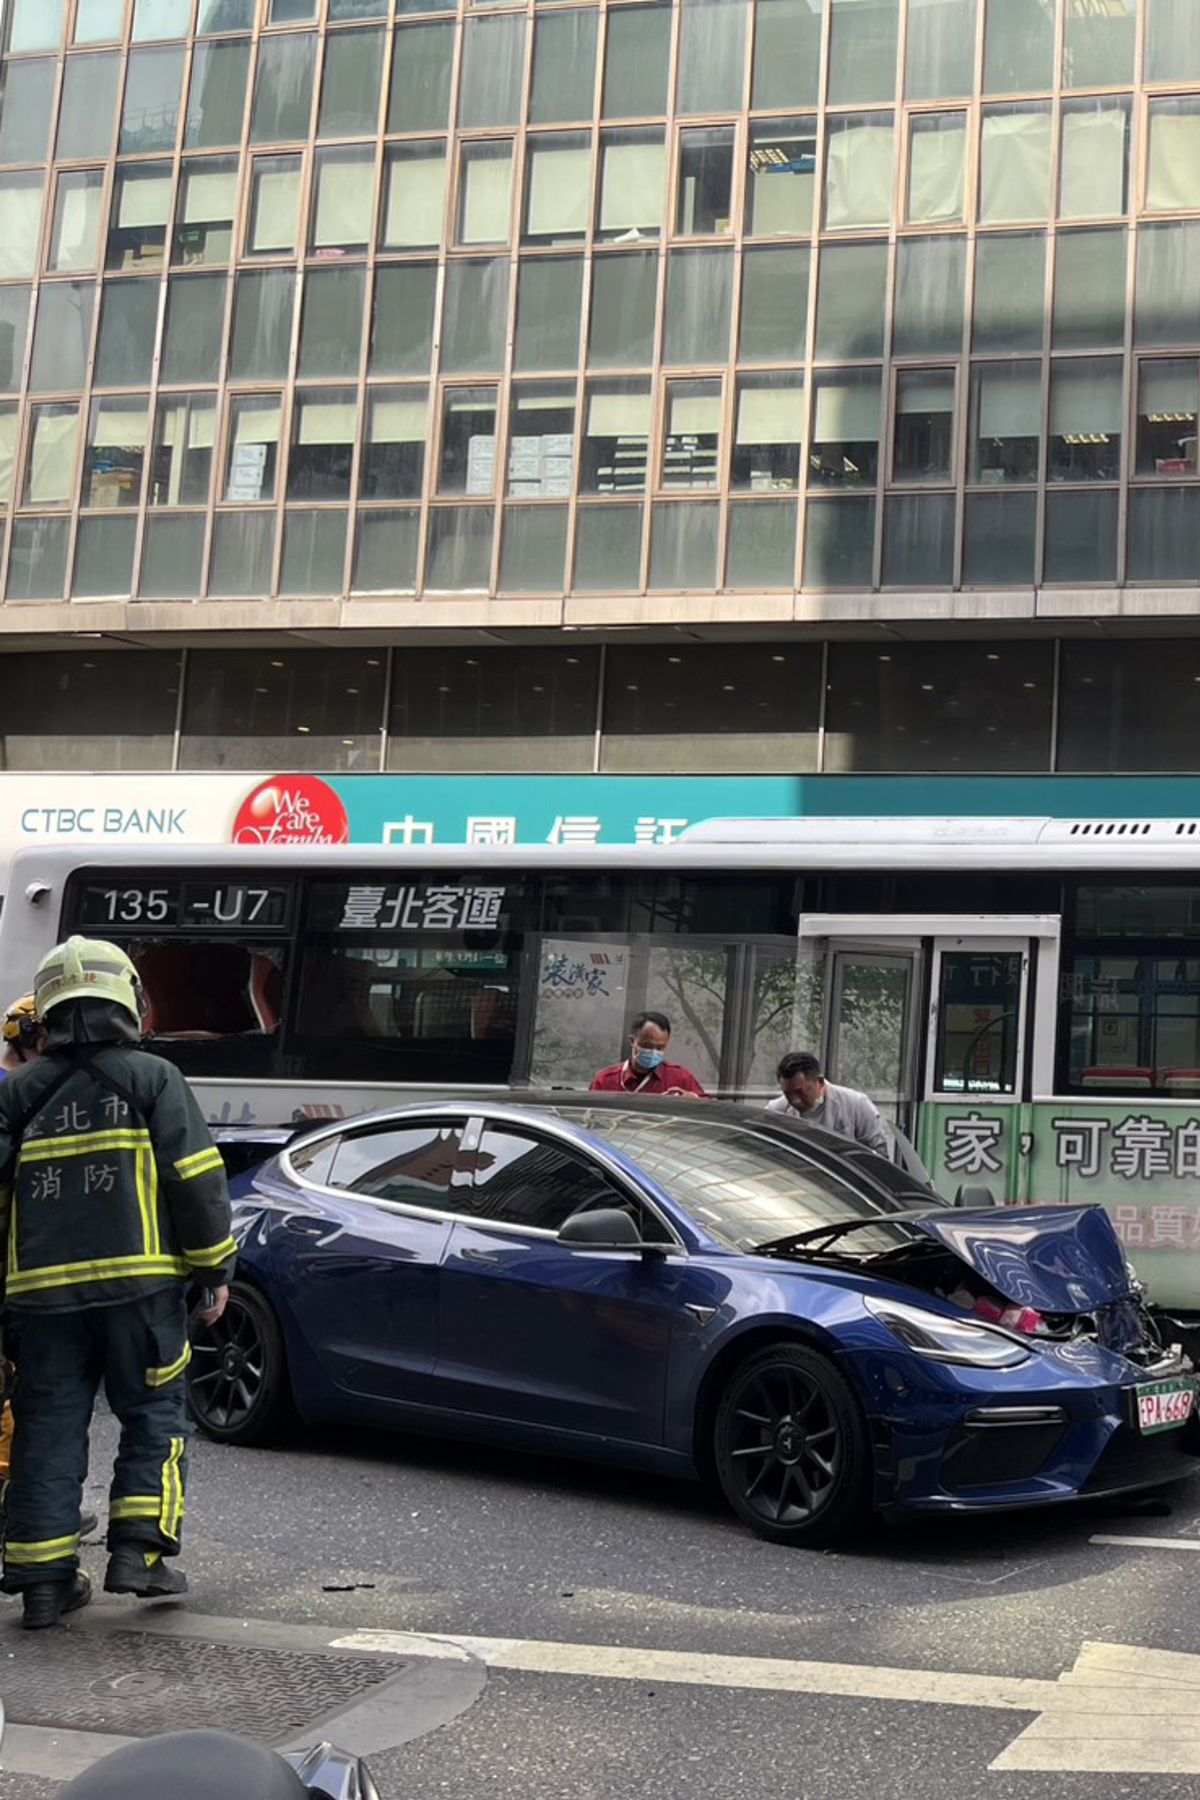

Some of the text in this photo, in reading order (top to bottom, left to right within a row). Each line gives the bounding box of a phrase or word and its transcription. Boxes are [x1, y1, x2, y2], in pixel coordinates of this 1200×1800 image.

[269, 789, 310, 815] We
[21, 808, 187, 834] CTBC BANK
[103, 889, 170, 921] 135
[339, 885, 507, 930] 臺北客運
[30, 1164, 119, 1201] 消防
